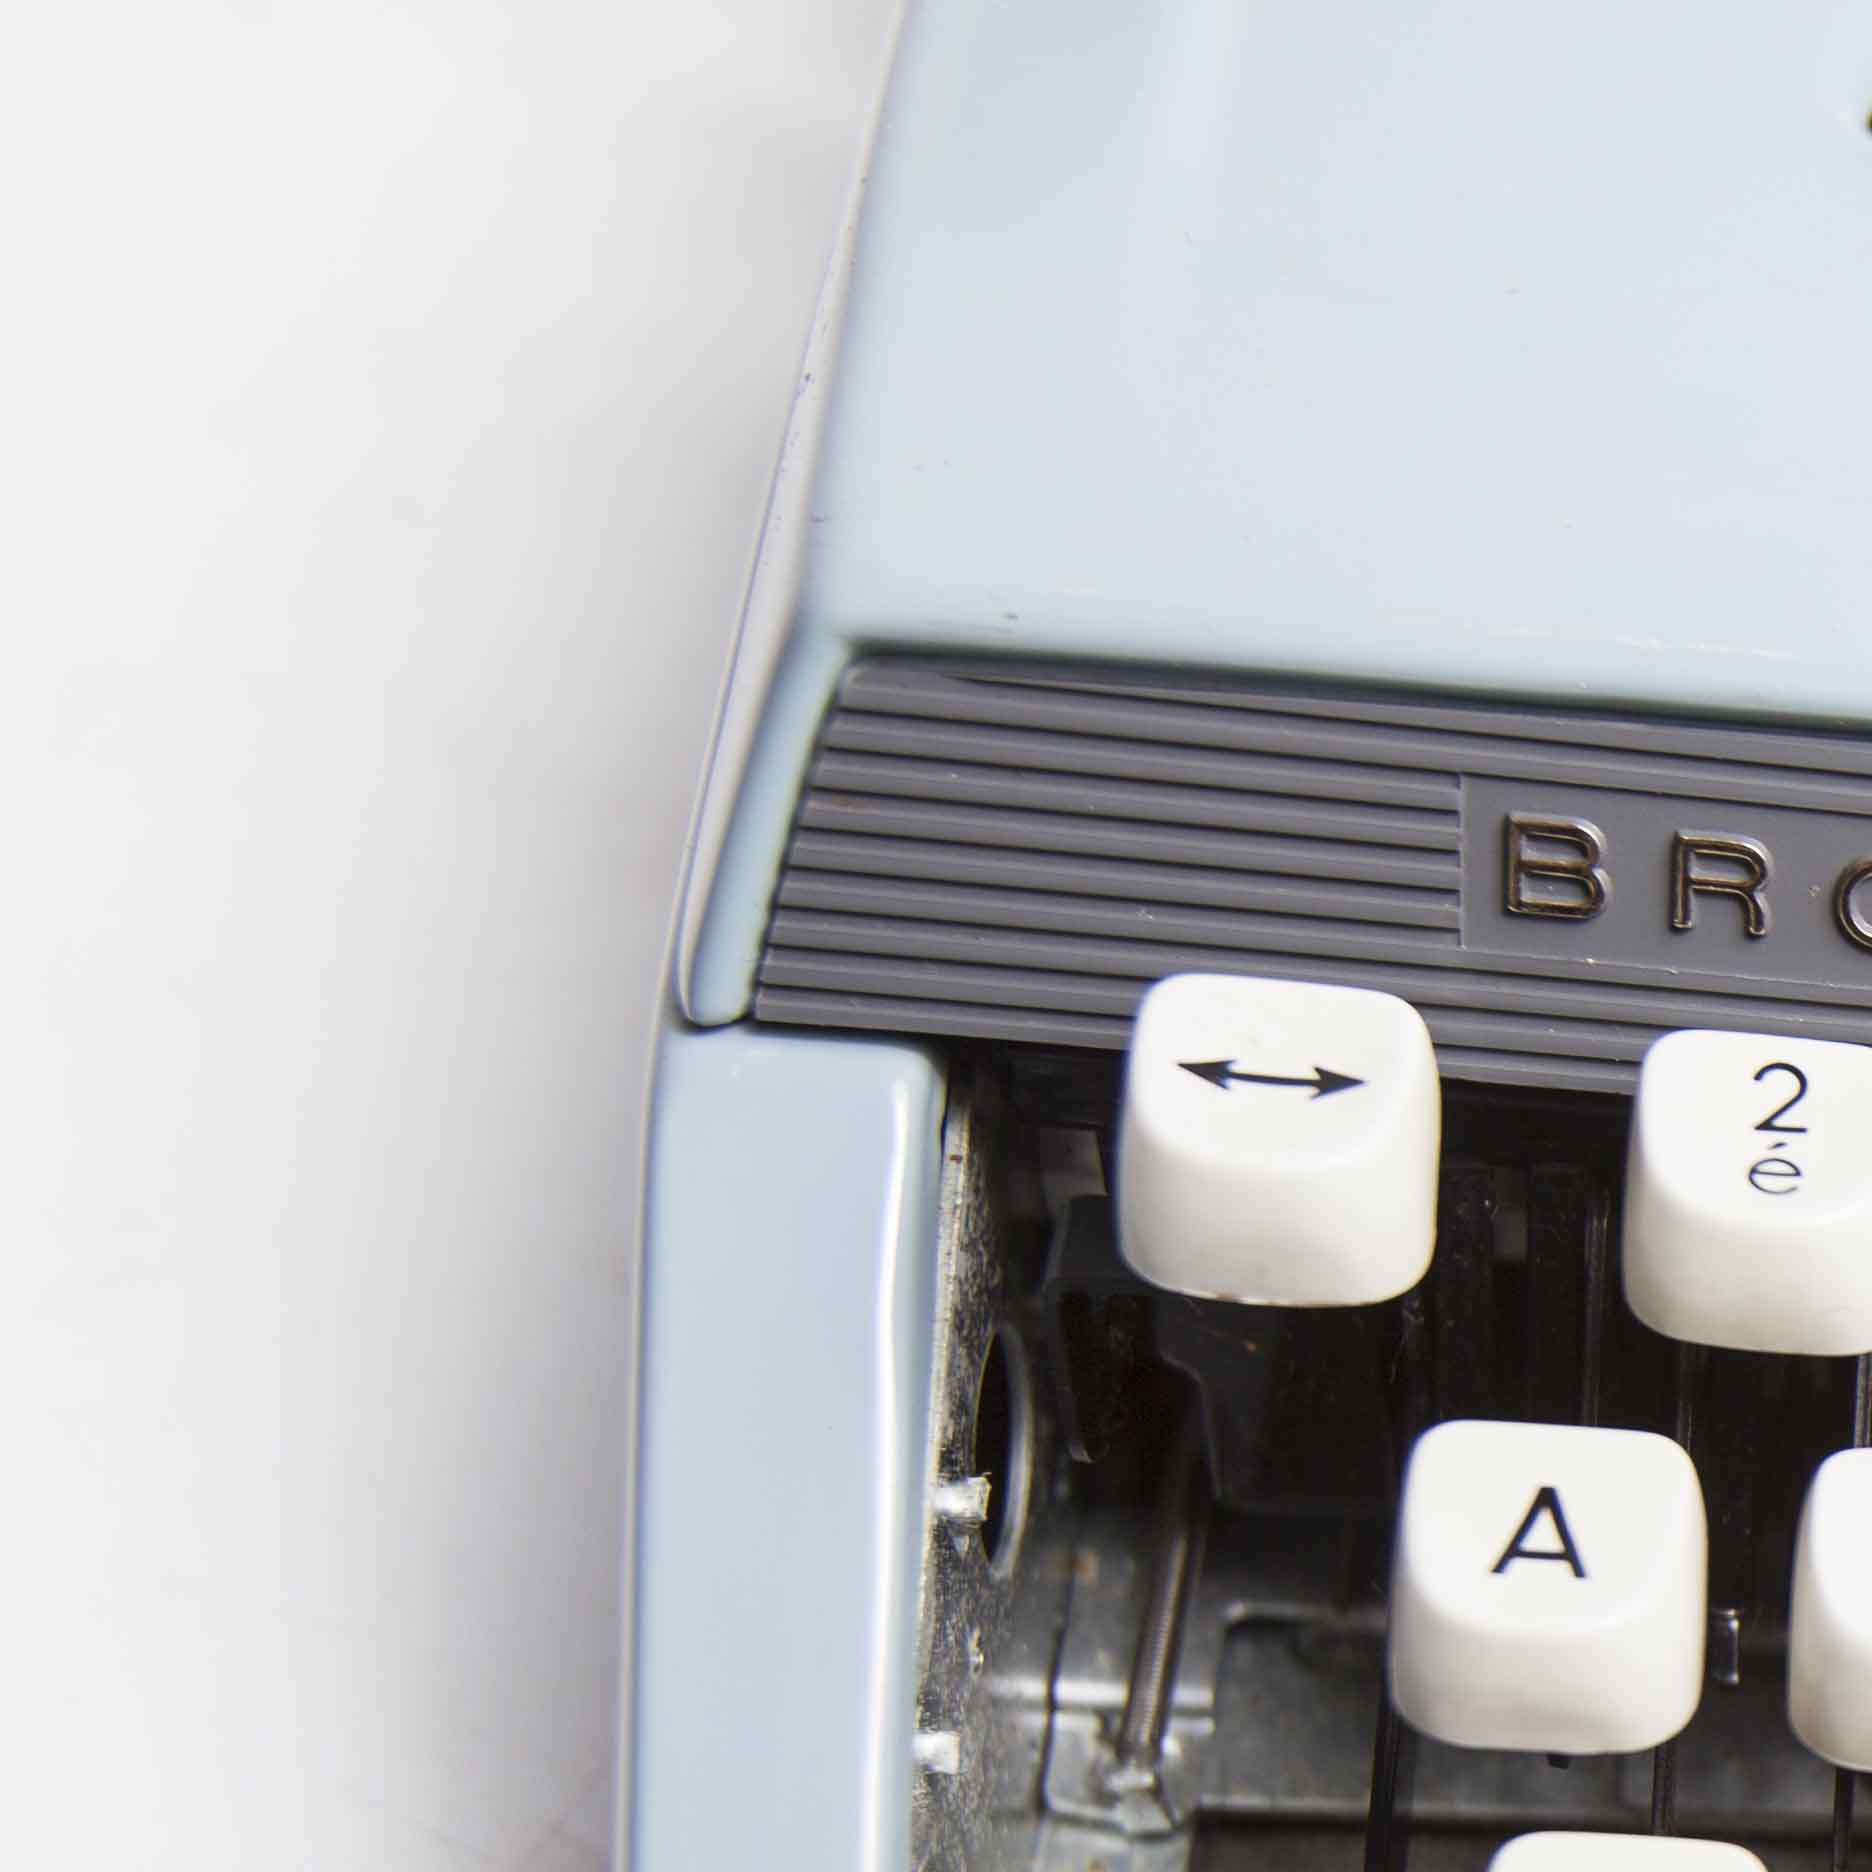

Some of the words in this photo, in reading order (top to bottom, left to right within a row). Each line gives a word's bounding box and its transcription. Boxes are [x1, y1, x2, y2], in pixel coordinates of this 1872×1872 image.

[1753, 1062, 1808, 1134] 2
[1748, 1141, 1802, 1195] é
[1491, 1486, 1586, 1579] A
